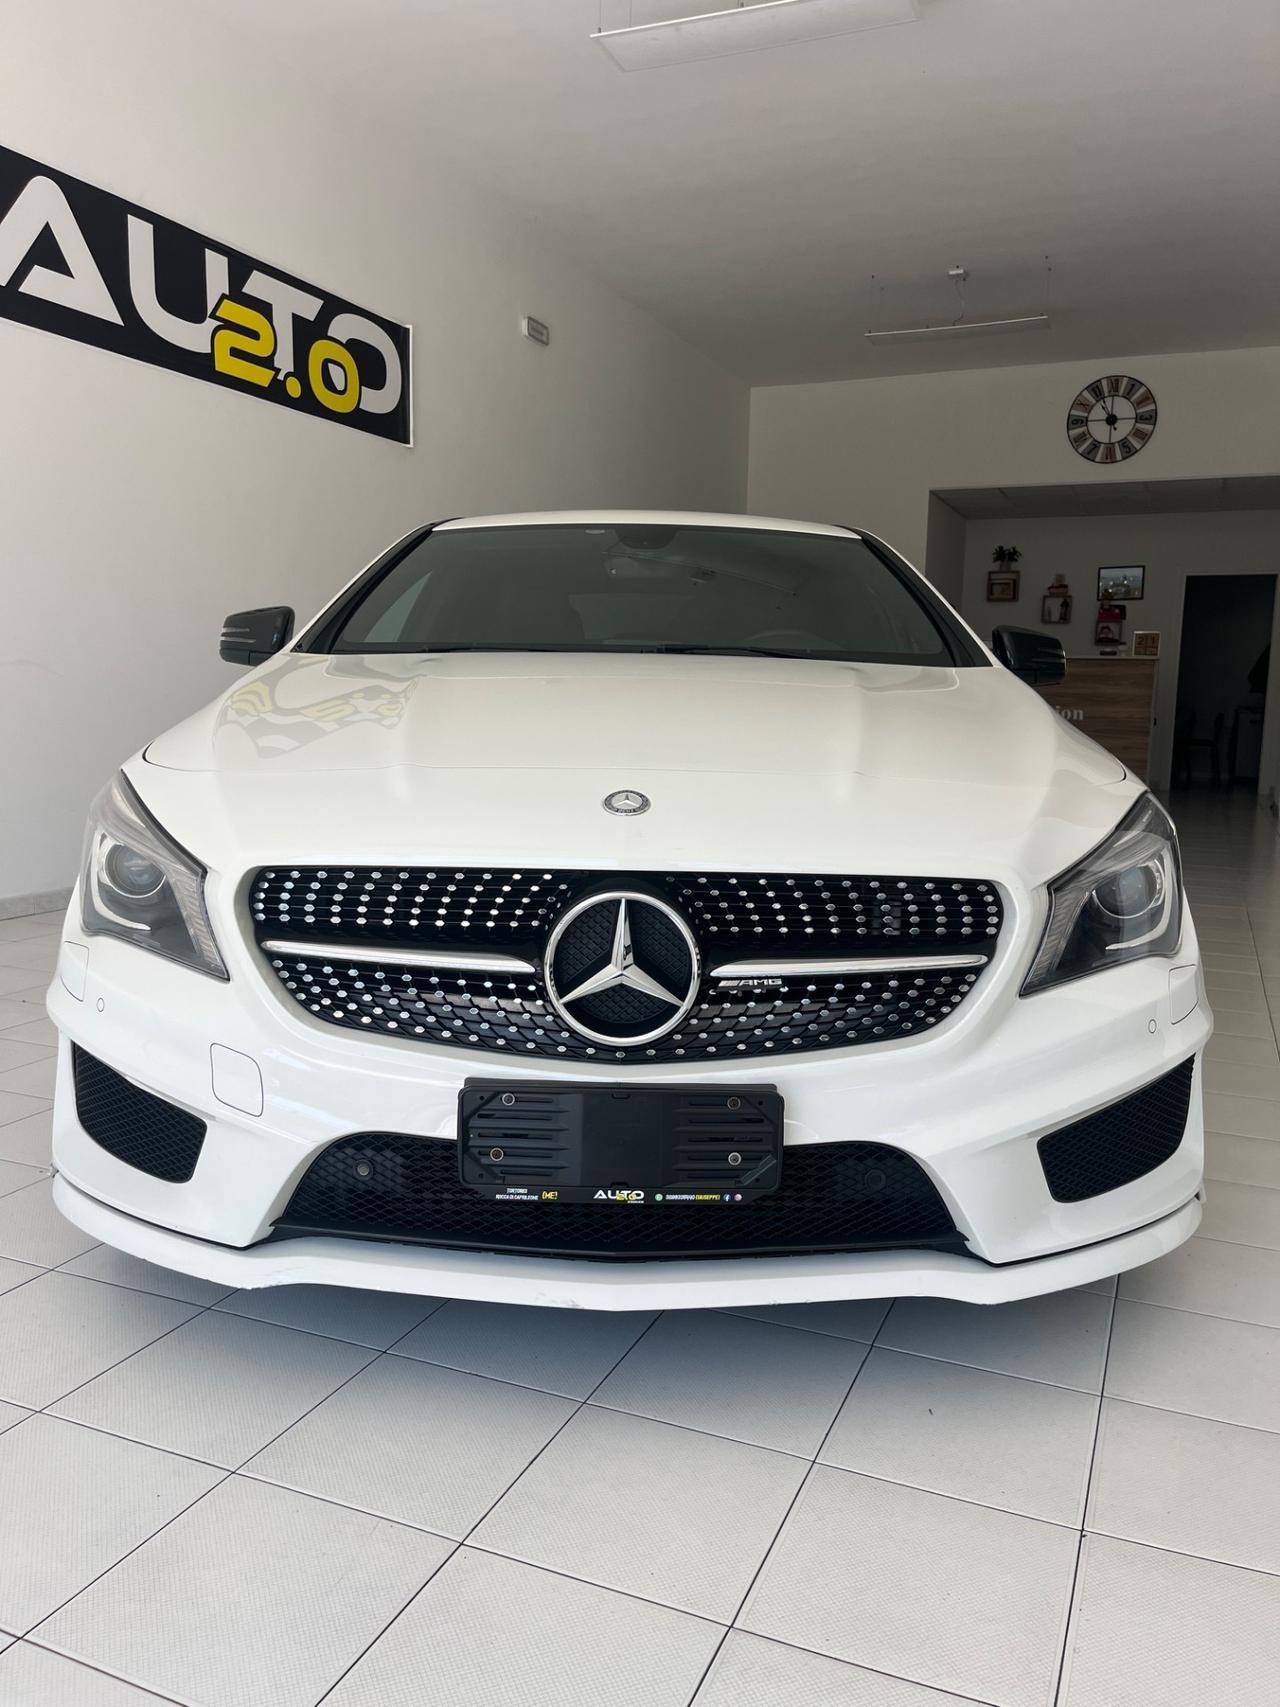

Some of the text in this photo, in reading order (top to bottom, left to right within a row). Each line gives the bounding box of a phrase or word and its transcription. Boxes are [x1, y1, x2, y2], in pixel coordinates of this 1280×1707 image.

[0, 175, 402, 414] AUTO
[213, 298, 360, 414] 2.0
[739, 978, 782, 987] AMG
[594, 1190, 645, 1200] AUTO
